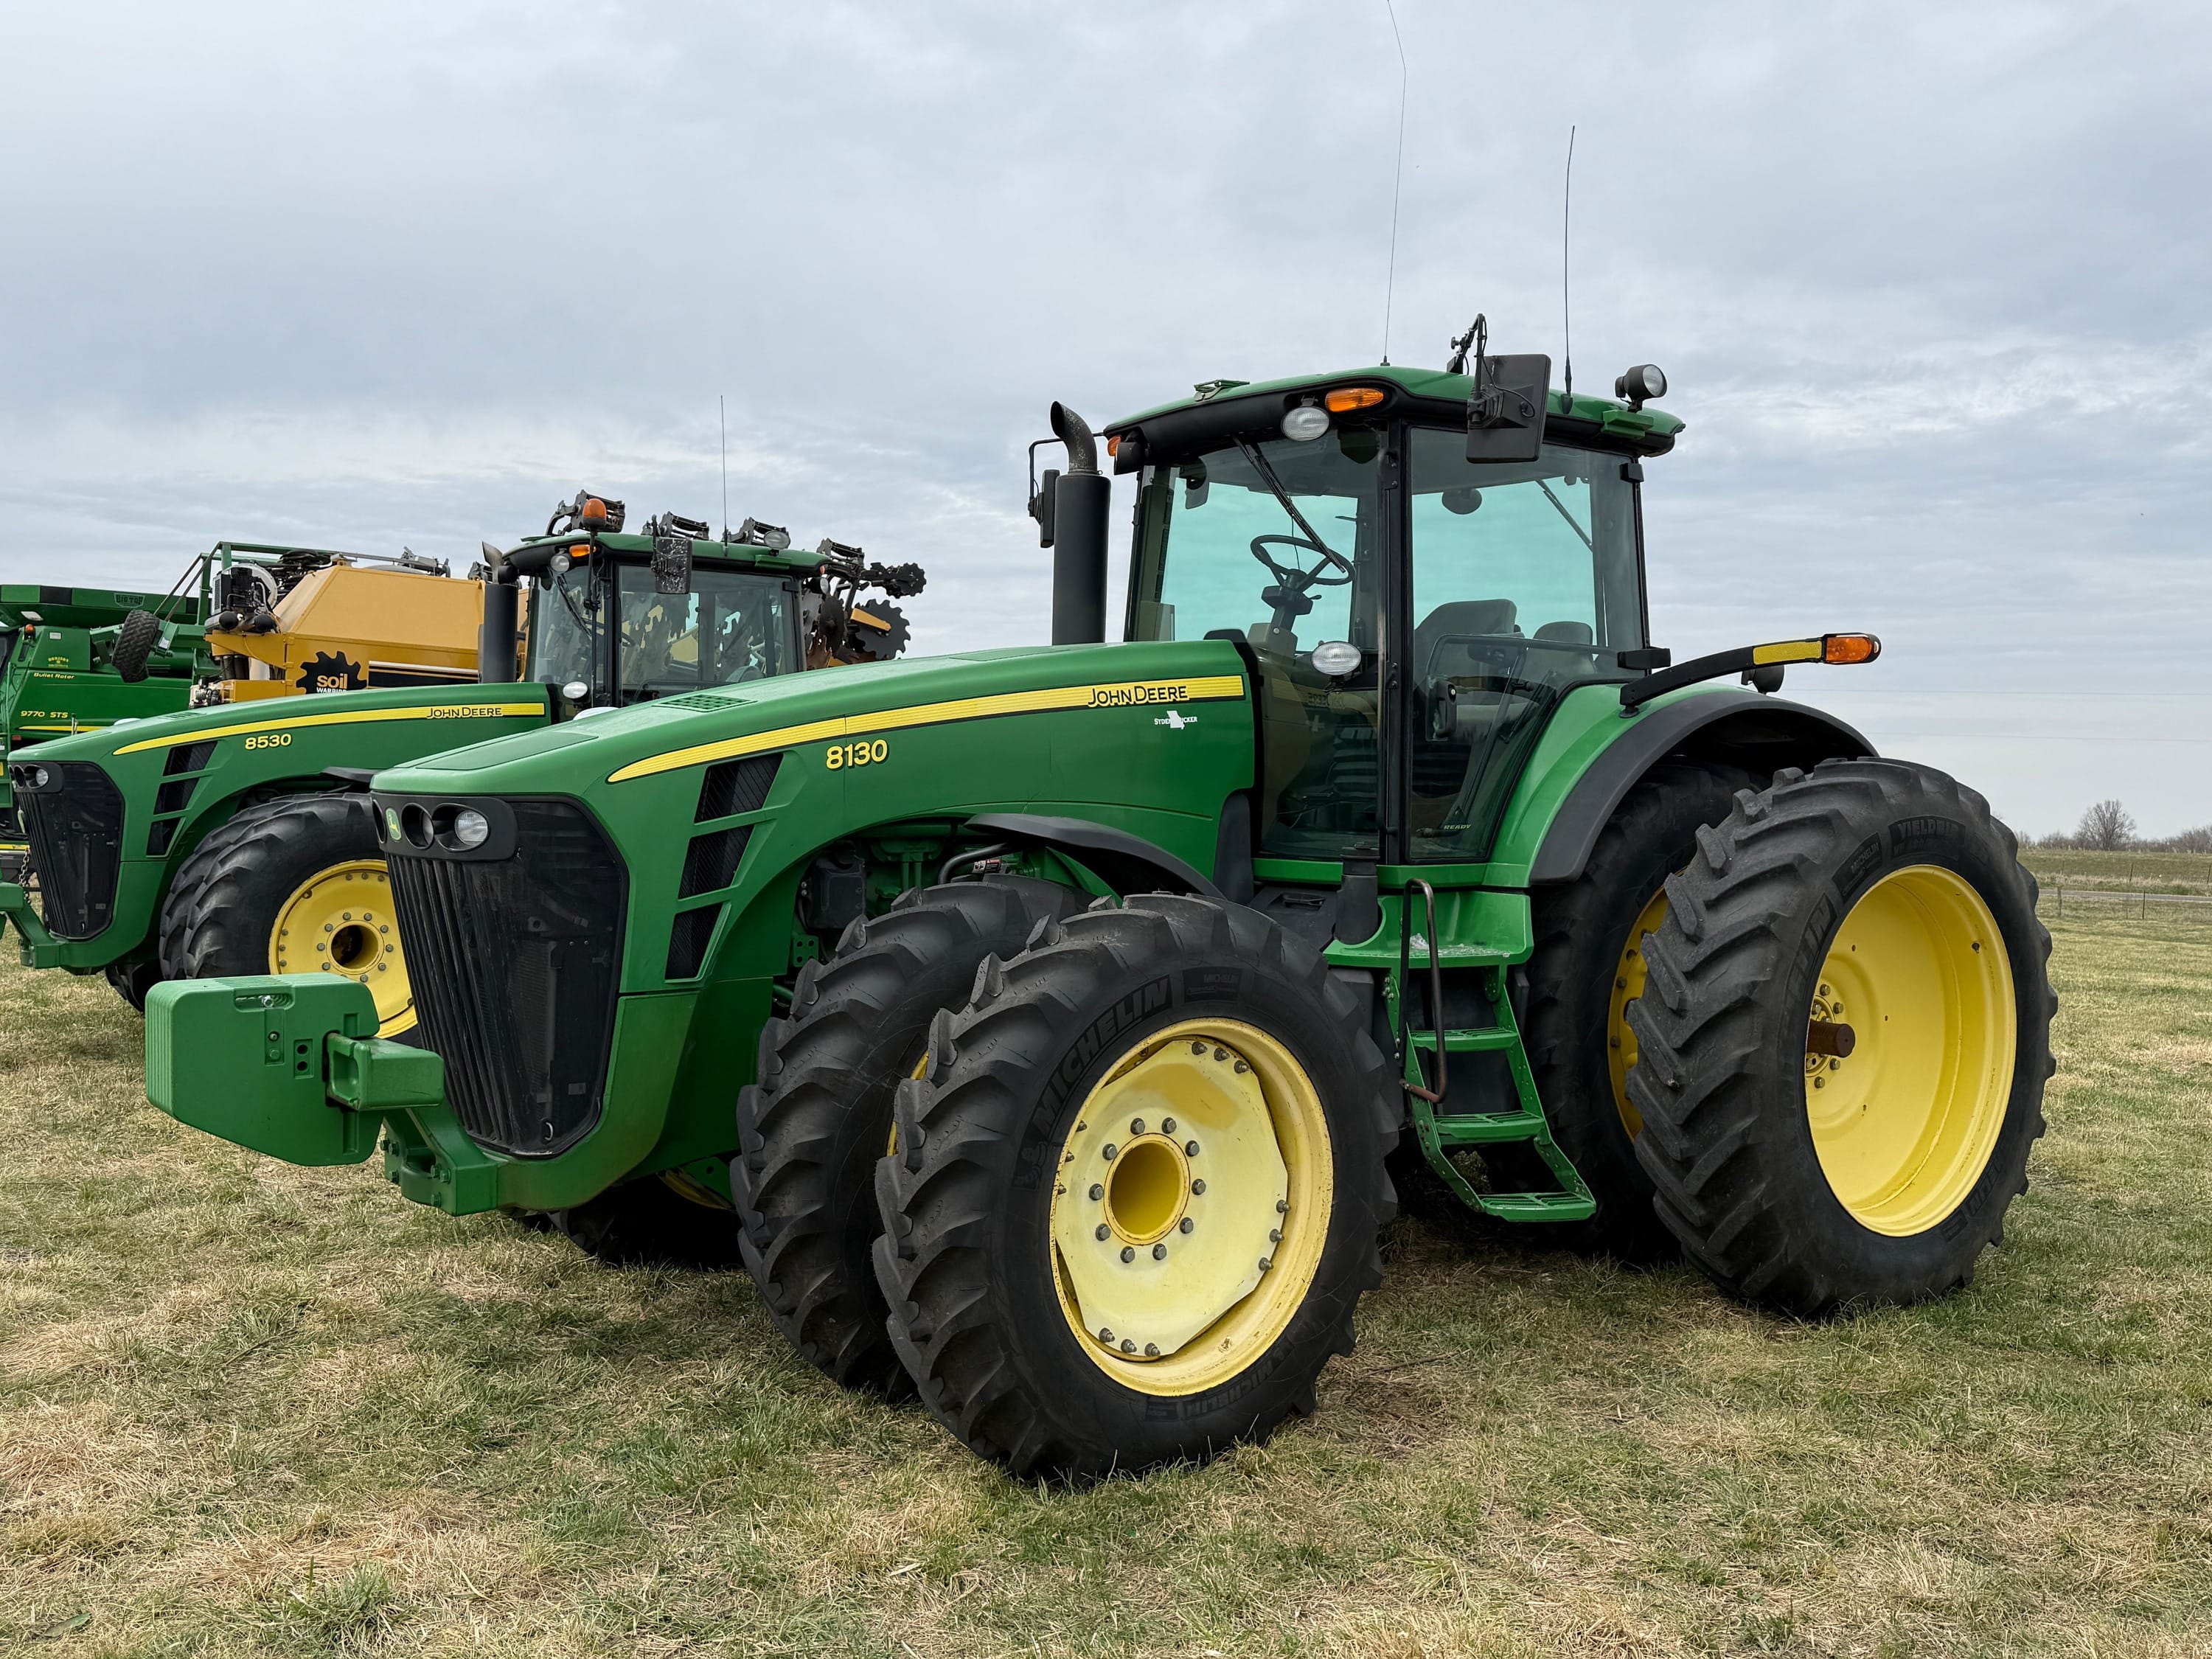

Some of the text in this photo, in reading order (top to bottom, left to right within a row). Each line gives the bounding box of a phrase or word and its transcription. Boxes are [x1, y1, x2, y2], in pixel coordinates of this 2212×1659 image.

[316, 673, 348, 689] soil
[1088, 685, 1189, 706] JOHN DEERE
[426, 706, 502, 718] JOHN DEERE
[245, 733, 292, 750] 8530
[826, 739, 889, 770] 8130
[1033, 978, 1171, 1138] MICHELIN
